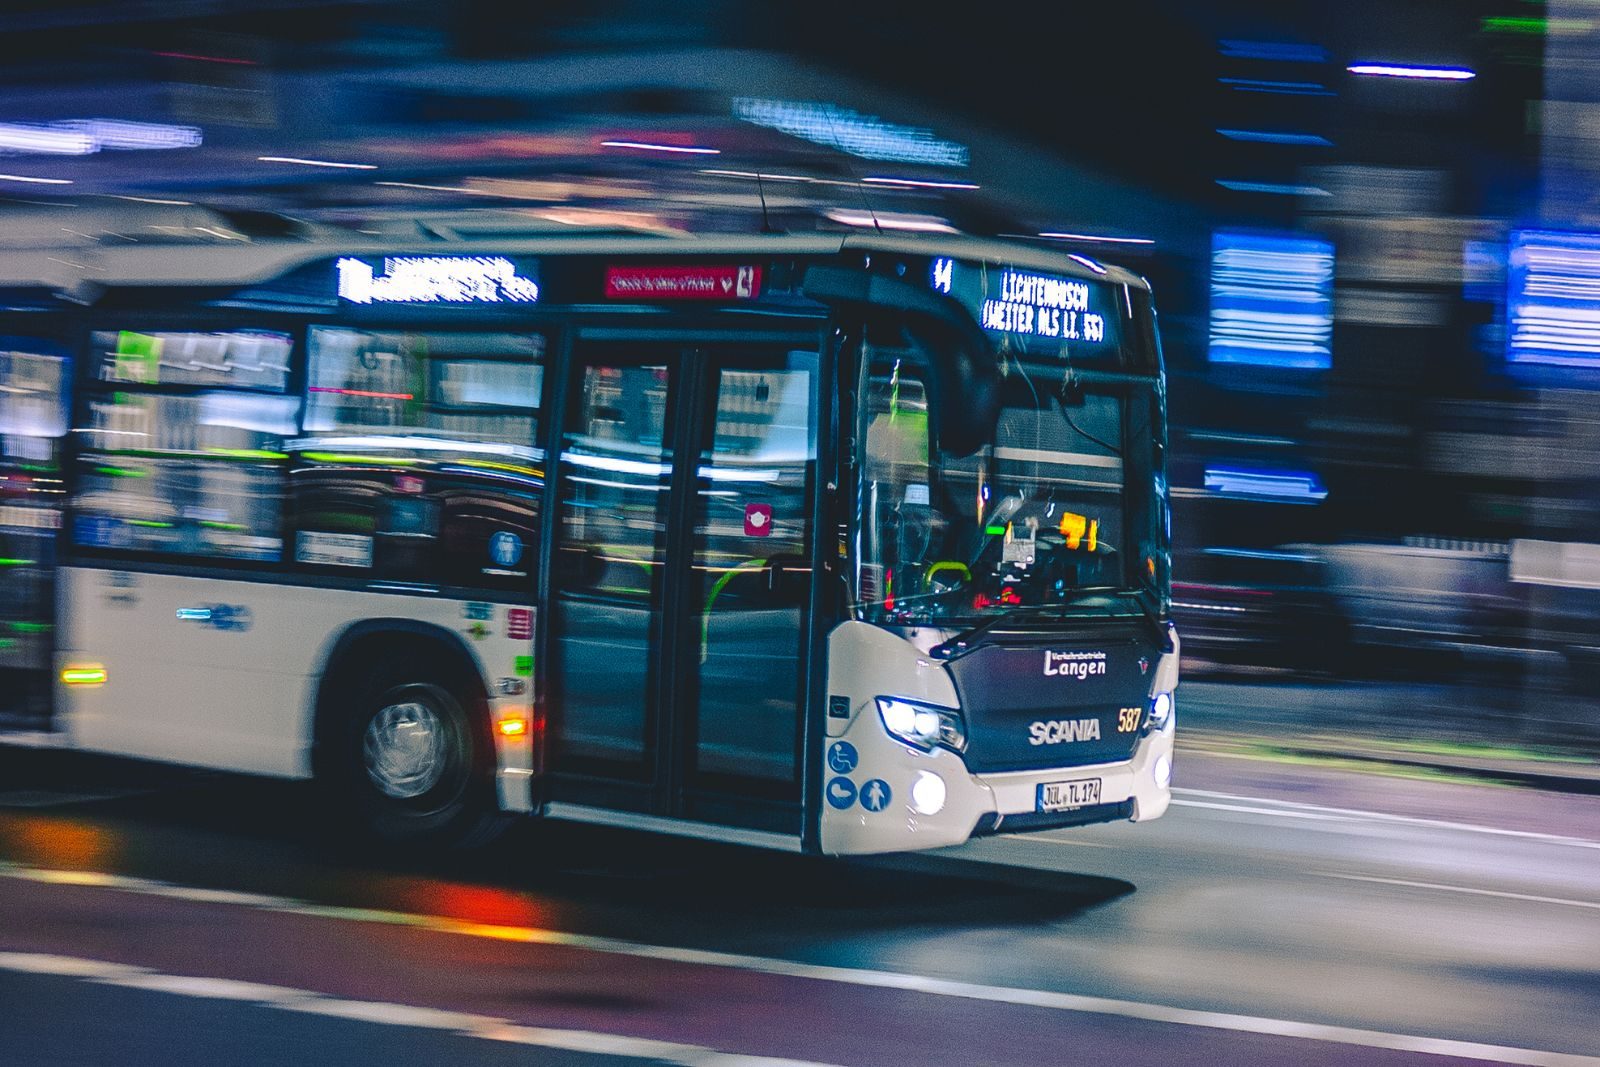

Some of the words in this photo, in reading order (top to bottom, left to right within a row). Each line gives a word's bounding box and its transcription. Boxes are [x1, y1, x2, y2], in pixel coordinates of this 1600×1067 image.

[1044, 650, 1106, 680] Langen
[1028, 719, 1101, 745] SCANIA
[1117, 708, 1142, 732] 587
[1082, 782, 1098, 802] 174
